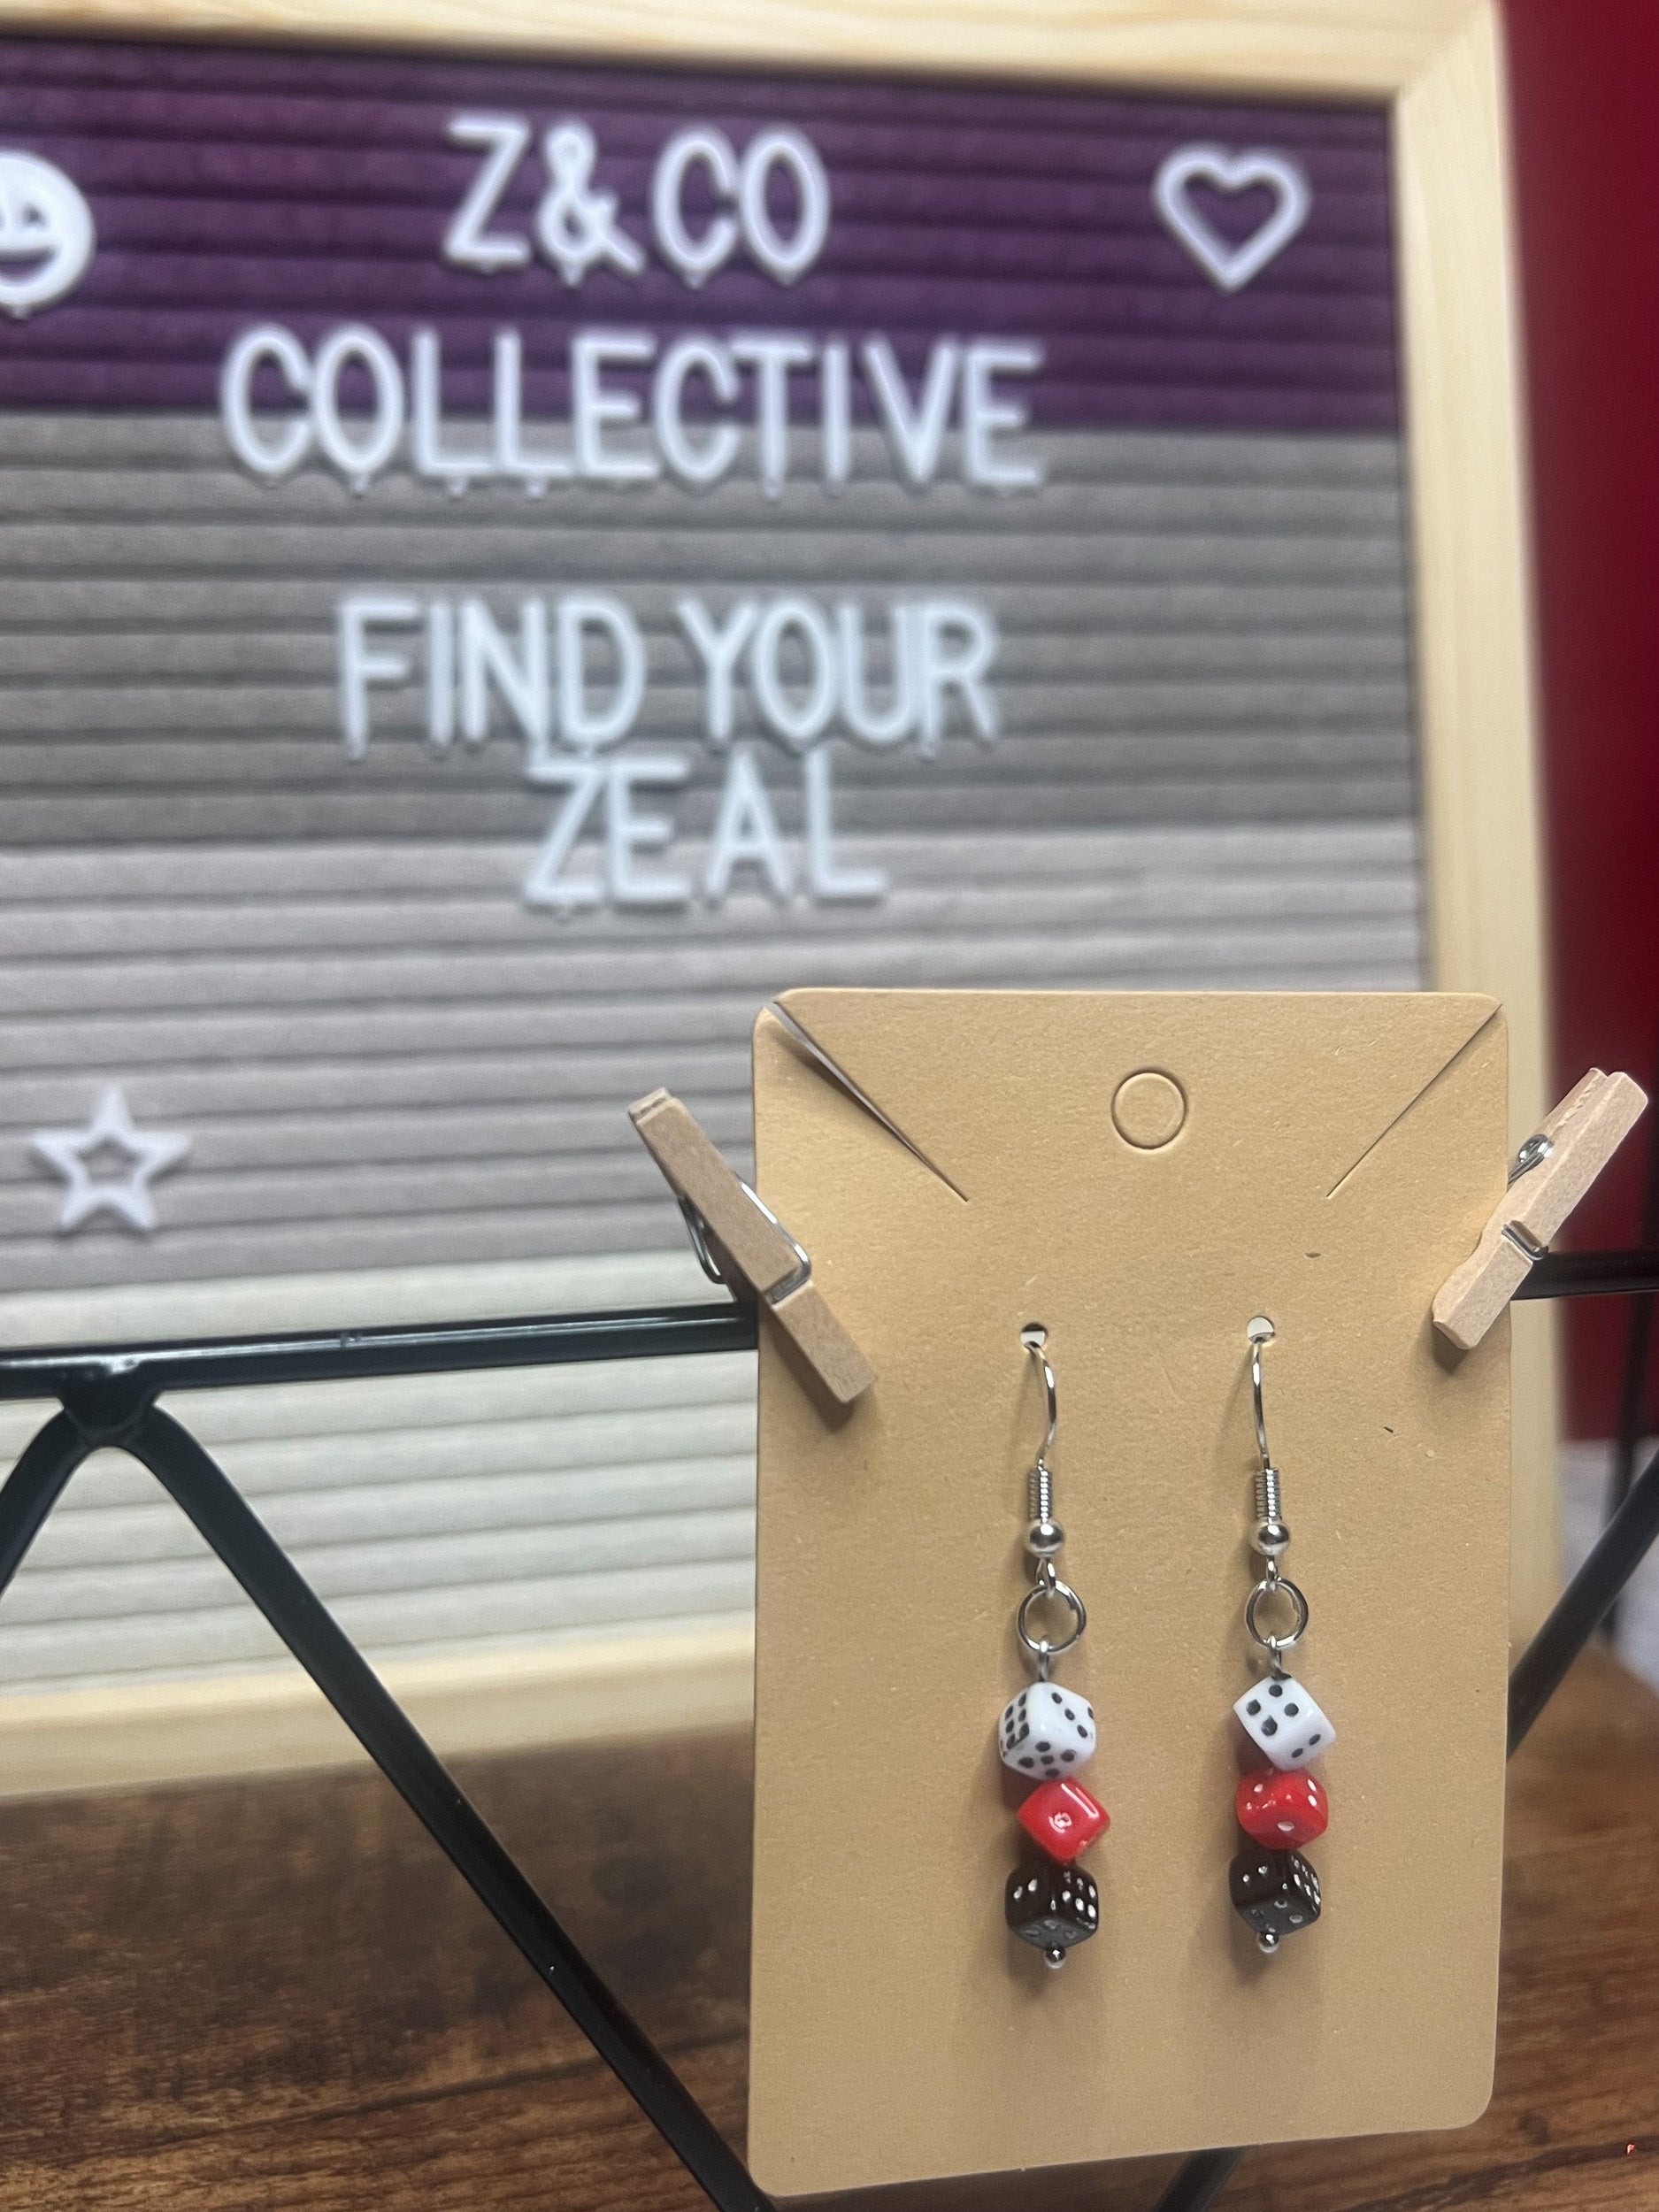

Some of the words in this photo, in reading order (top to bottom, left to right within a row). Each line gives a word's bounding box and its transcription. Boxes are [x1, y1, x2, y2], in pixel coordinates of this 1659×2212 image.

[221, 323, 1046, 489] COLLECTIVE
[336, 593, 647, 750] FIND
[675, 593, 1002, 750] YOUR
[522, 750, 890, 910] ZEAL
